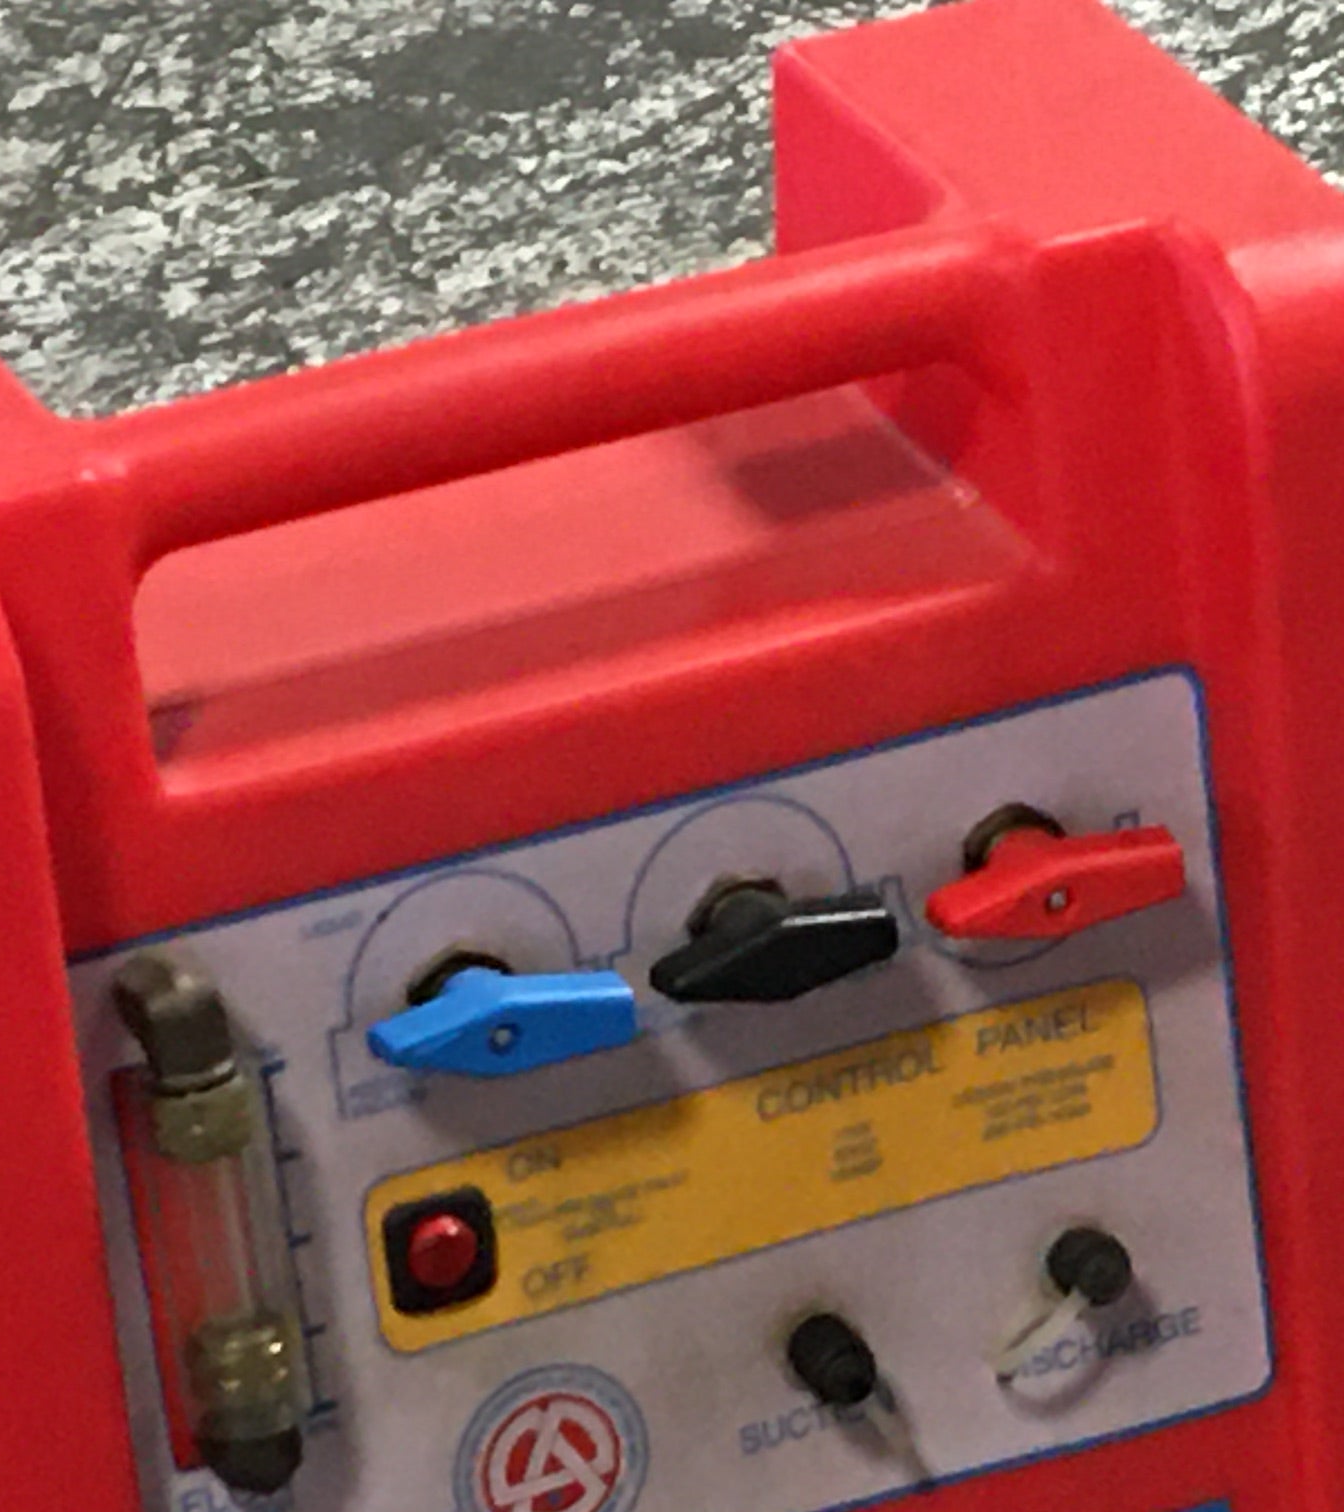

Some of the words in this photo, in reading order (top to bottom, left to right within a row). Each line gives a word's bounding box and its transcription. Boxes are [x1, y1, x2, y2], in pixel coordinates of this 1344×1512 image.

[756, 1033, 945, 1123] CONTROL
[976, 1002, 1098, 1056] PANEL
[507, 1147, 562, 1183] ON
[522, 1252, 590, 1299] OFF
